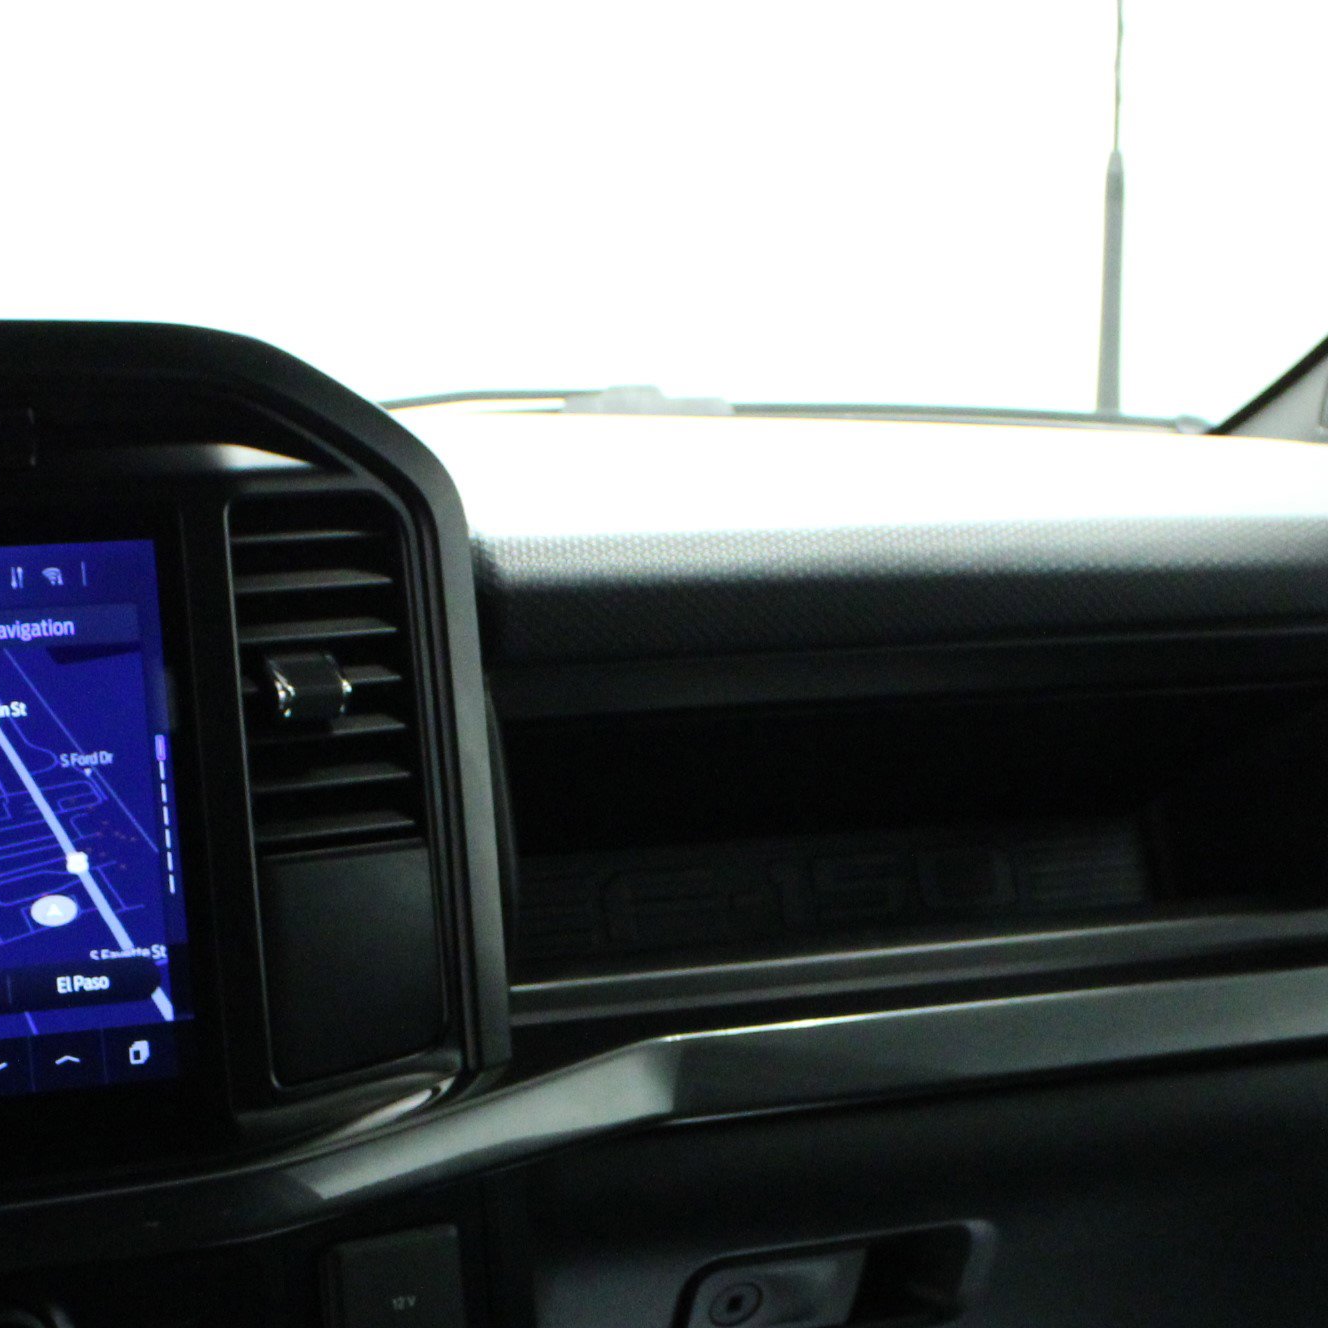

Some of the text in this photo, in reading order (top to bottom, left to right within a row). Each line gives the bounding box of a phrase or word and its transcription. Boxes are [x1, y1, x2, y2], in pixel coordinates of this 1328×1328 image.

[10, 701, 28, 717] St
[60, 750, 114, 768] S Ford Dr
[56, 974, 110, 994] El Paso
